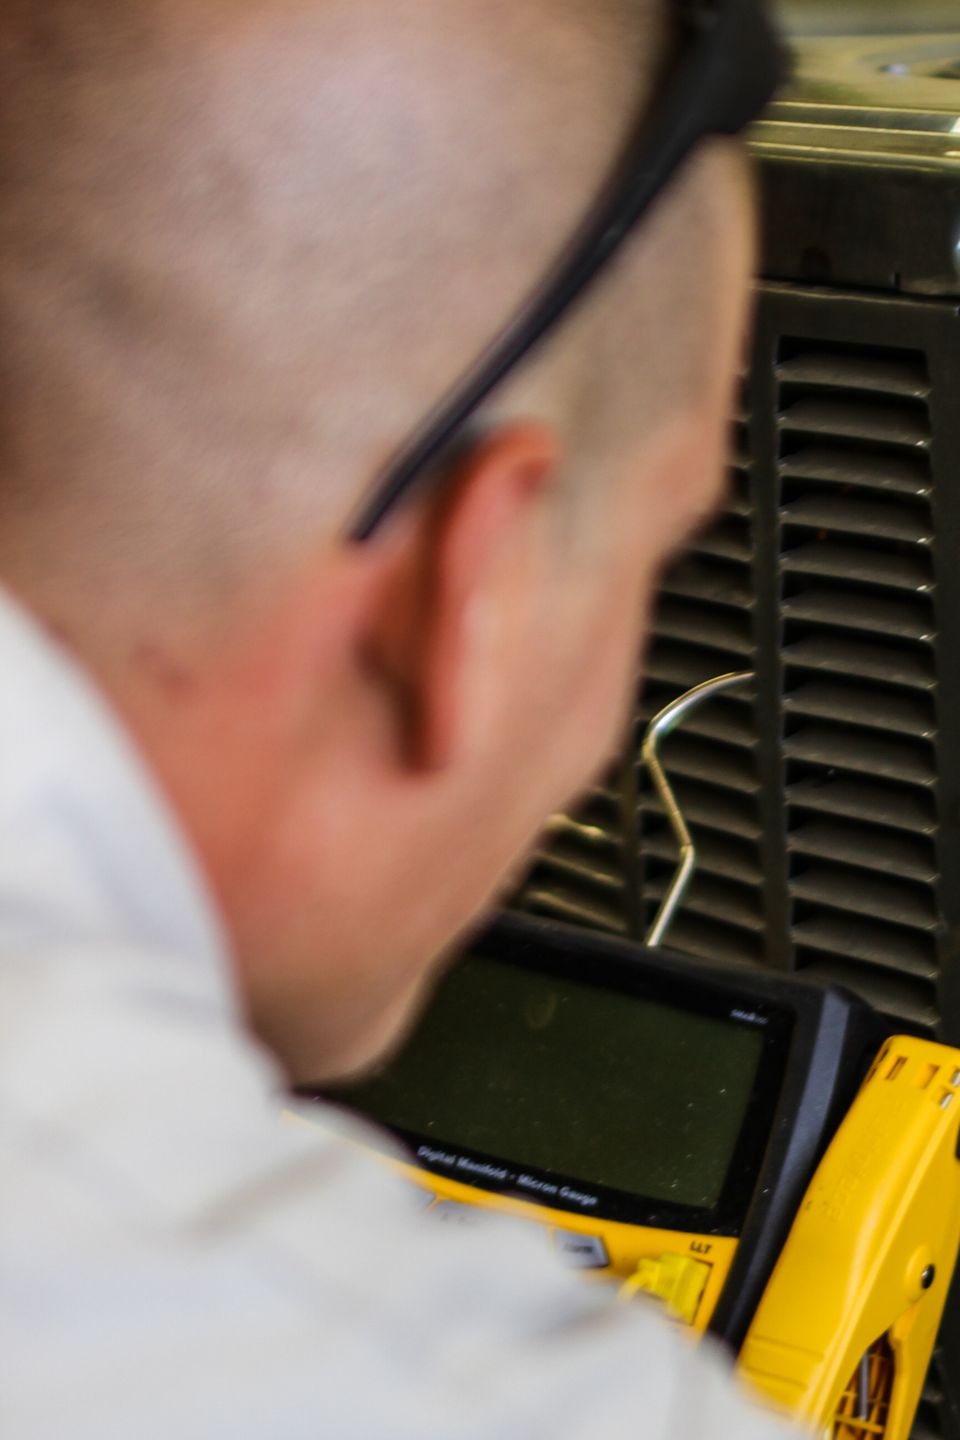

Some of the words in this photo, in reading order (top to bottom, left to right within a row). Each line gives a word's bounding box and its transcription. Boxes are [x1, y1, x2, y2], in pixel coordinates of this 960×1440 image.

[417, 1145, 457, 1166] Digital
[457, 1157, 508, 1180] Manifold
[516, 1173, 559, 1195] Micron
[559, 1186, 599, 1207] Gauge
[689, 1240, 712, 1255] LLT
